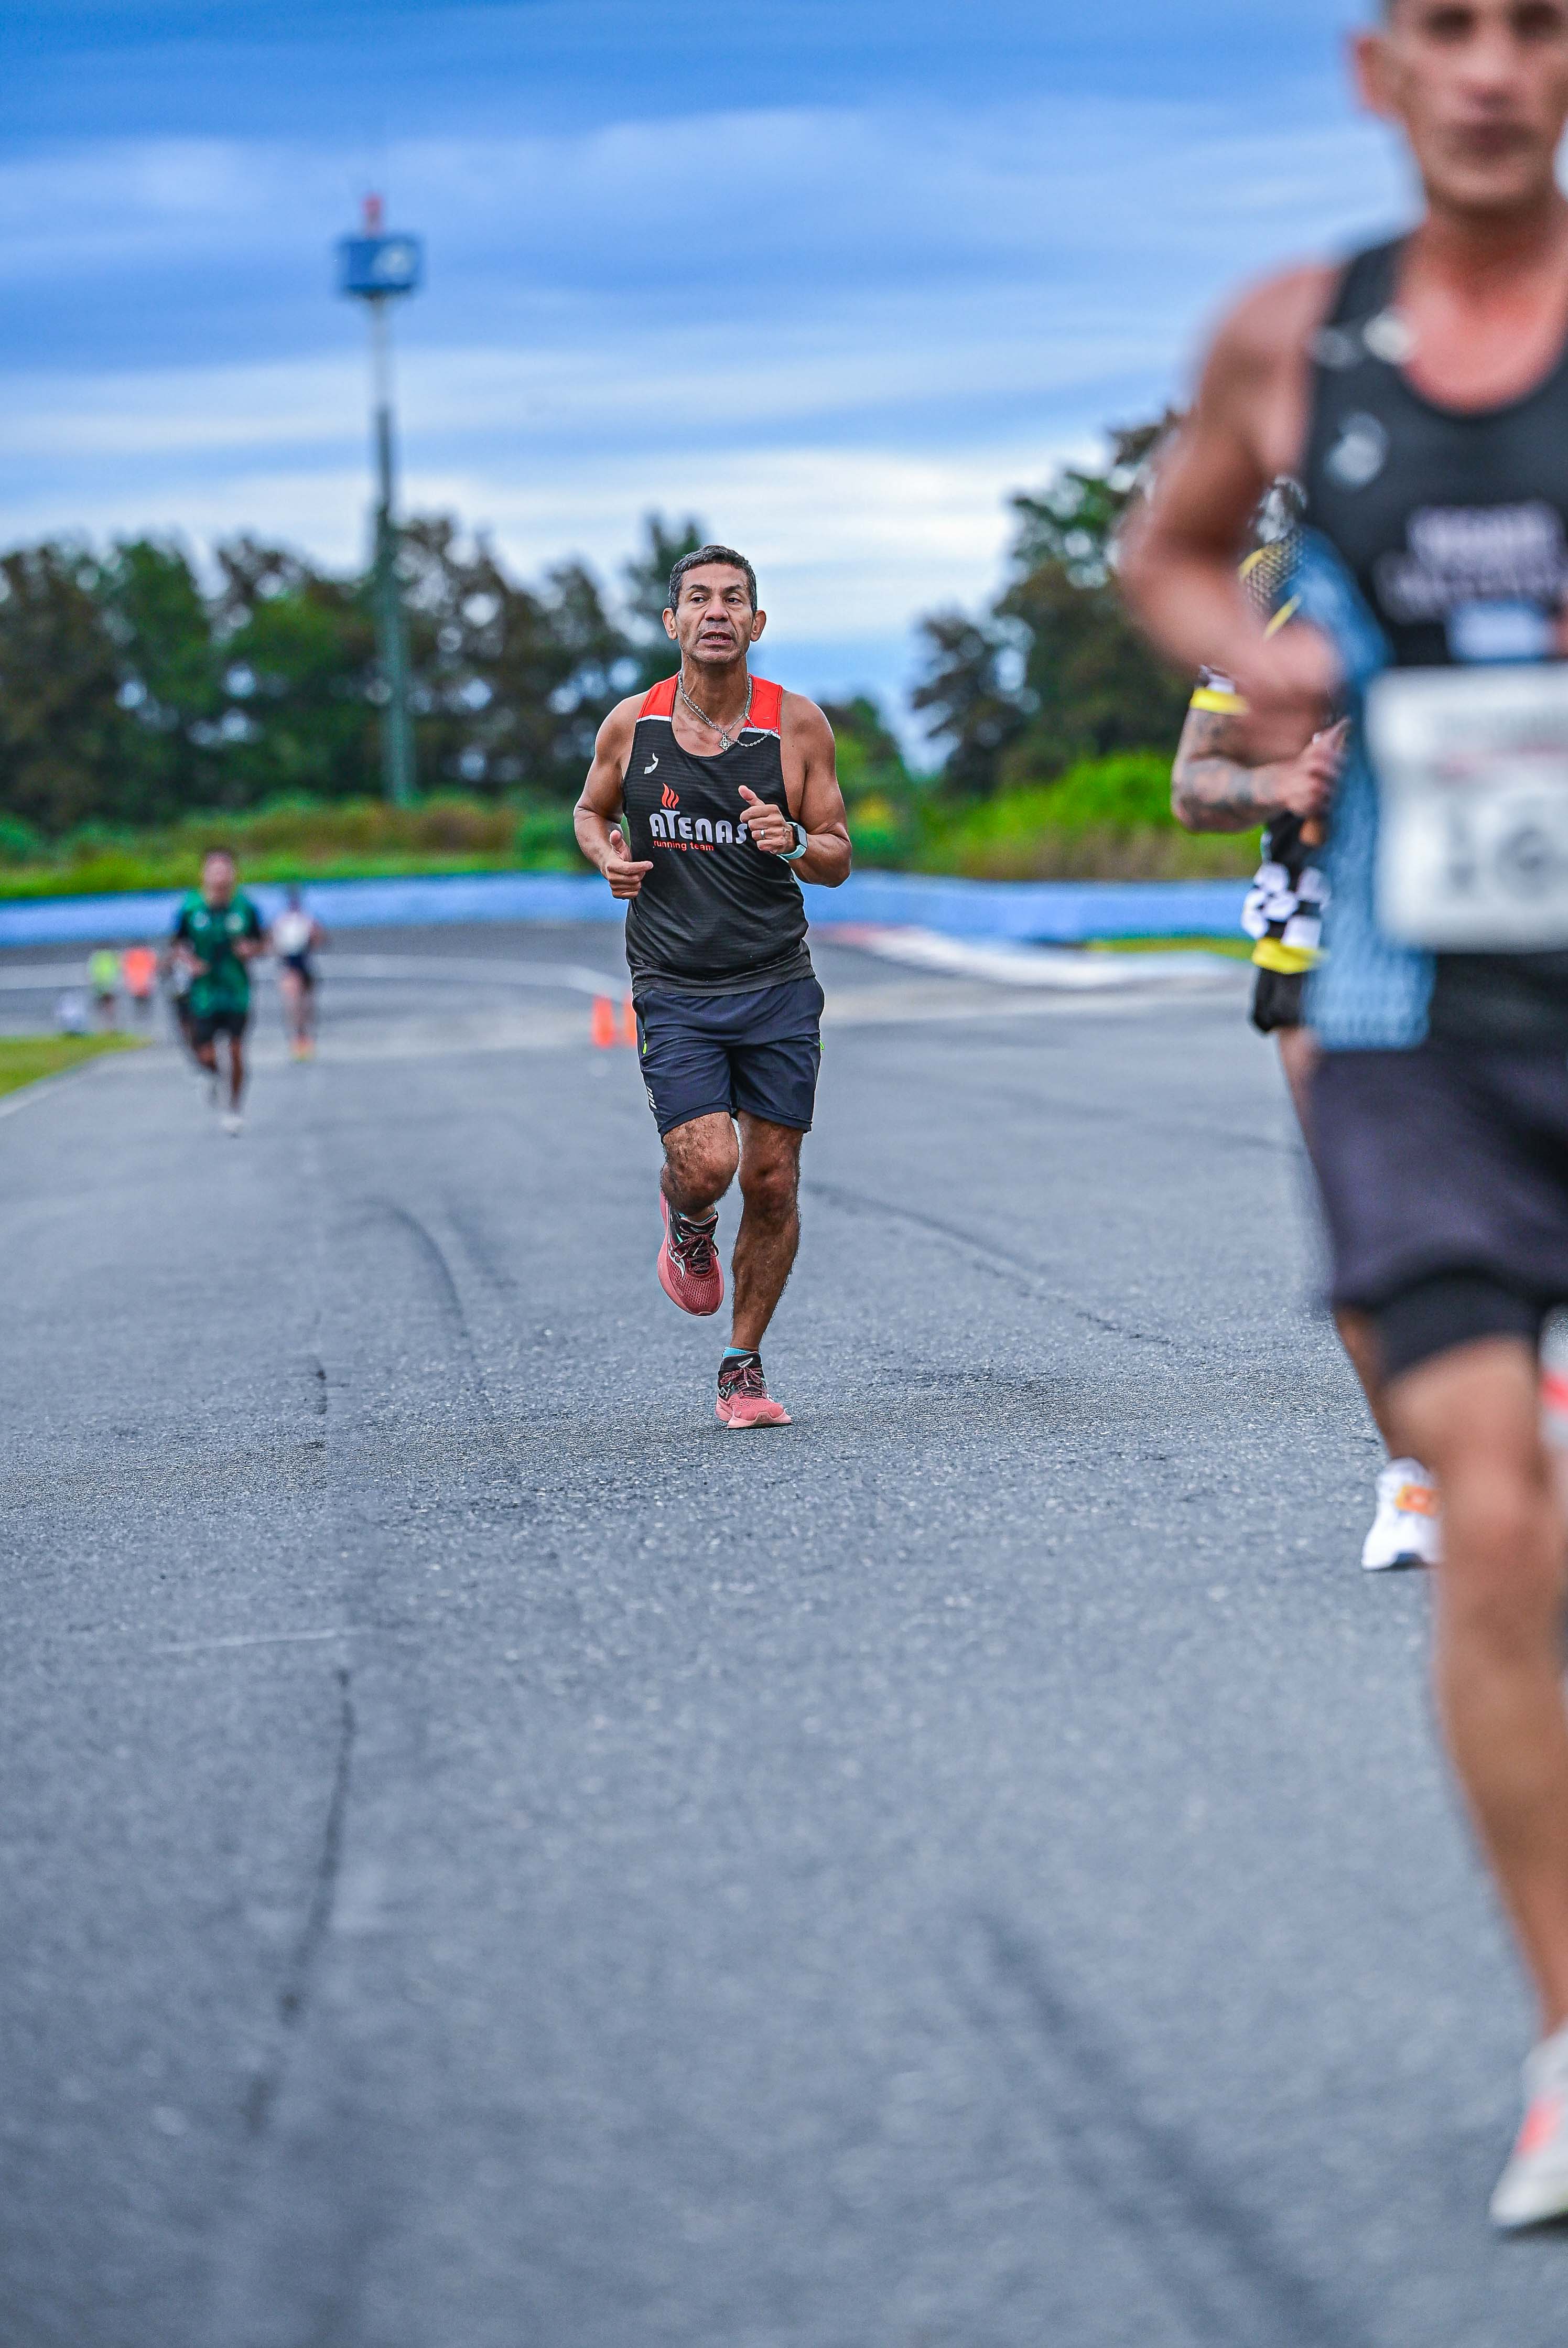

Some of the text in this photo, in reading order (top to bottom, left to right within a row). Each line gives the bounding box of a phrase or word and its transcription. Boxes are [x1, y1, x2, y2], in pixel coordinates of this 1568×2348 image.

[649, 809, 748, 844] ATENAS
[654, 841, 714, 852] running team
